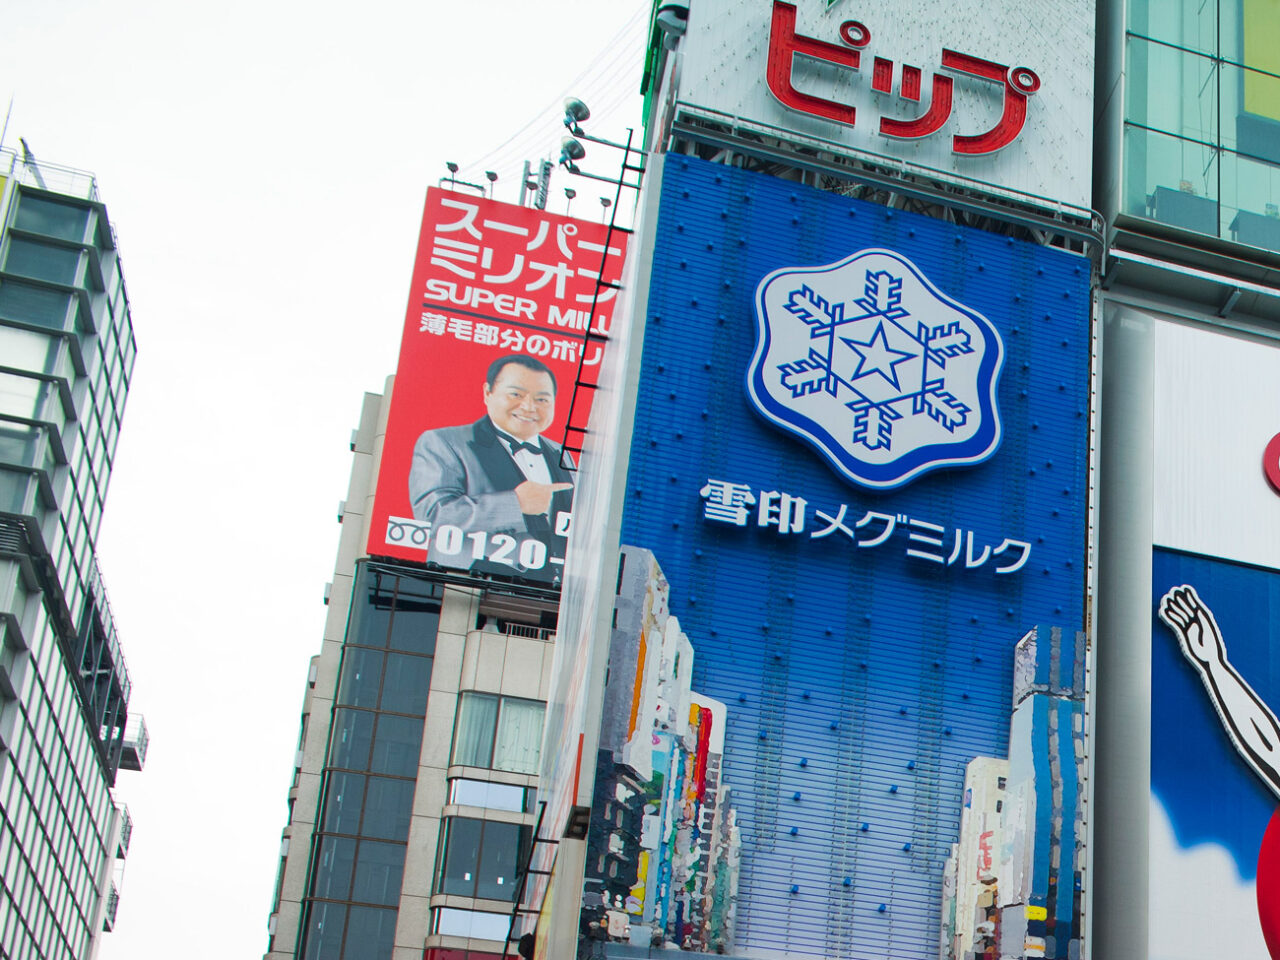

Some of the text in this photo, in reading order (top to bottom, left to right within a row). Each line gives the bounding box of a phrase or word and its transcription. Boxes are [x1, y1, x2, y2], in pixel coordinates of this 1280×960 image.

[766, 0, 1041, 158] ピップ
[435, 198, 621, 260] スーパー
[424, 278, 537, 321] SUPER
[430, 236, 620, 304] ミリオン
[435, 524, 565, 570] 0120-
[698, 478, 1033, 574] 雪印メグミルク
